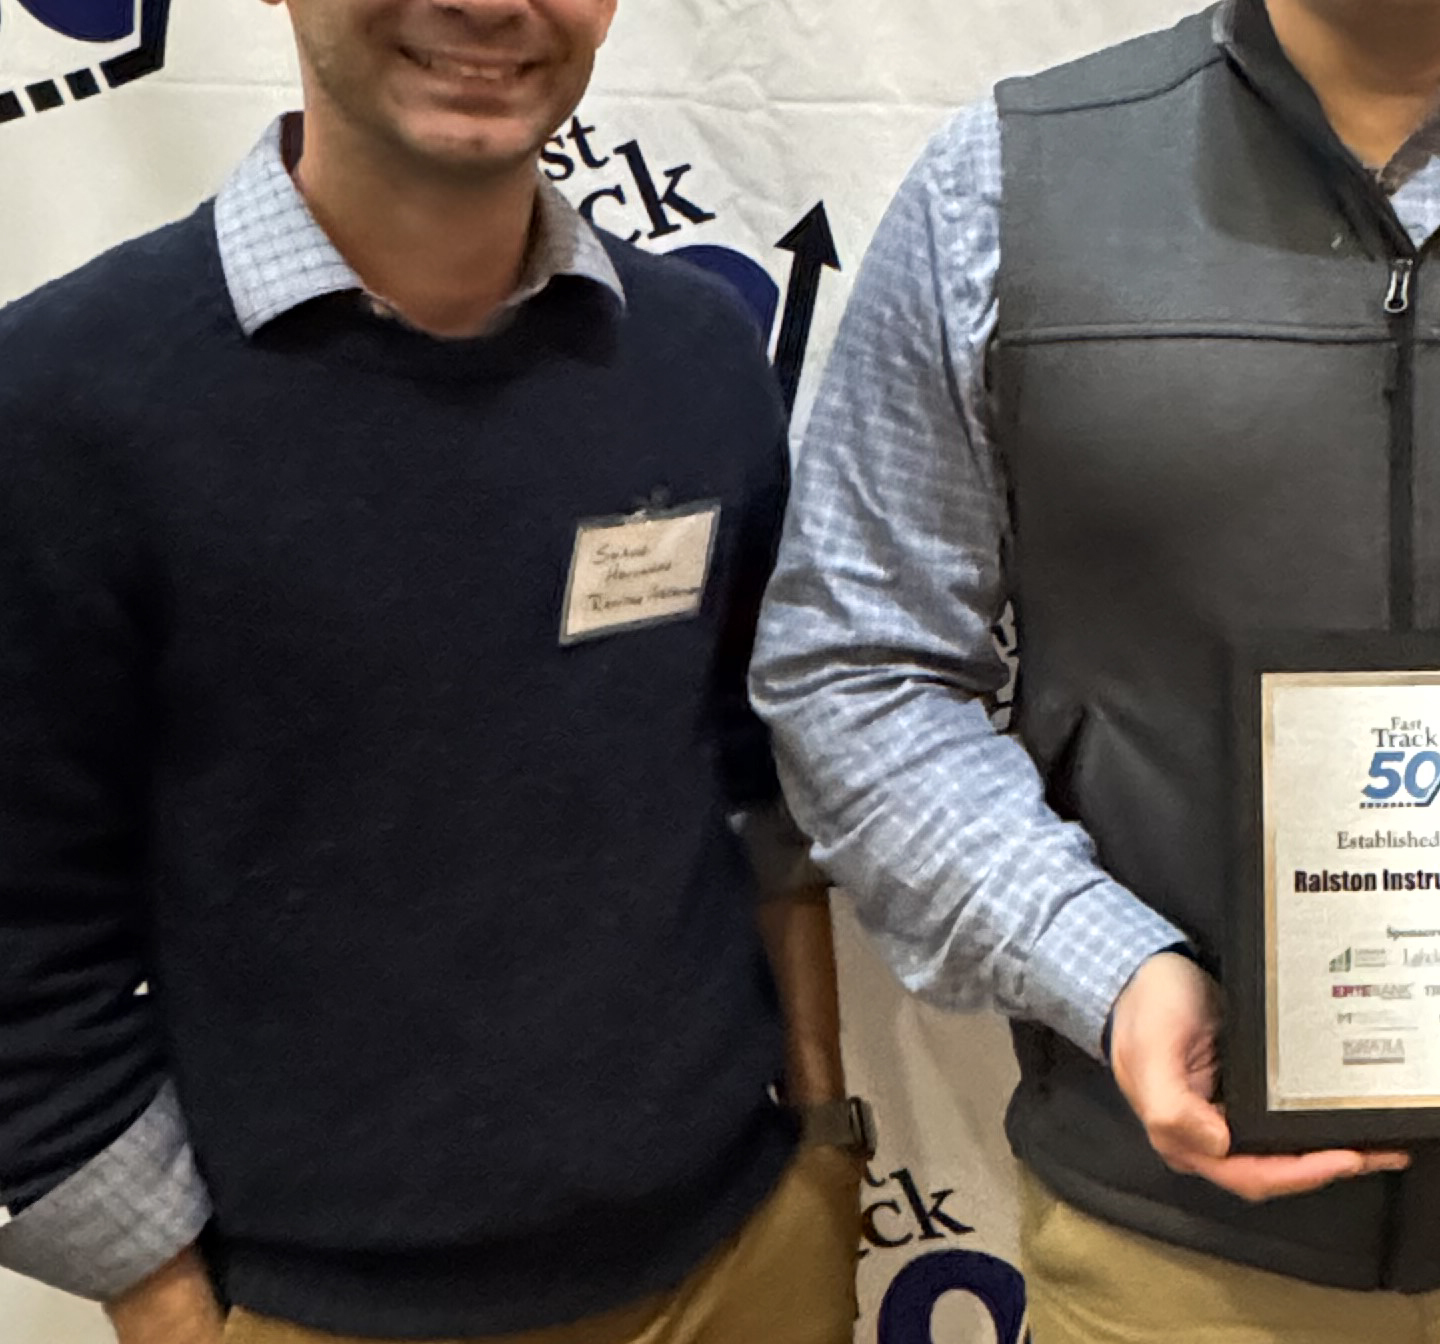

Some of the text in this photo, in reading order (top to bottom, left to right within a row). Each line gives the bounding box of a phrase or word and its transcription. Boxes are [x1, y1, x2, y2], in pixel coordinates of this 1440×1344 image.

[541, 115, 610, 181] st
[1390, 716, 1422, 731] Fast
[1371, 726, 1438, 747] Track
[1336, 829, 1440, 849] Established
[1294, 869, 1377, 893] Ralston
